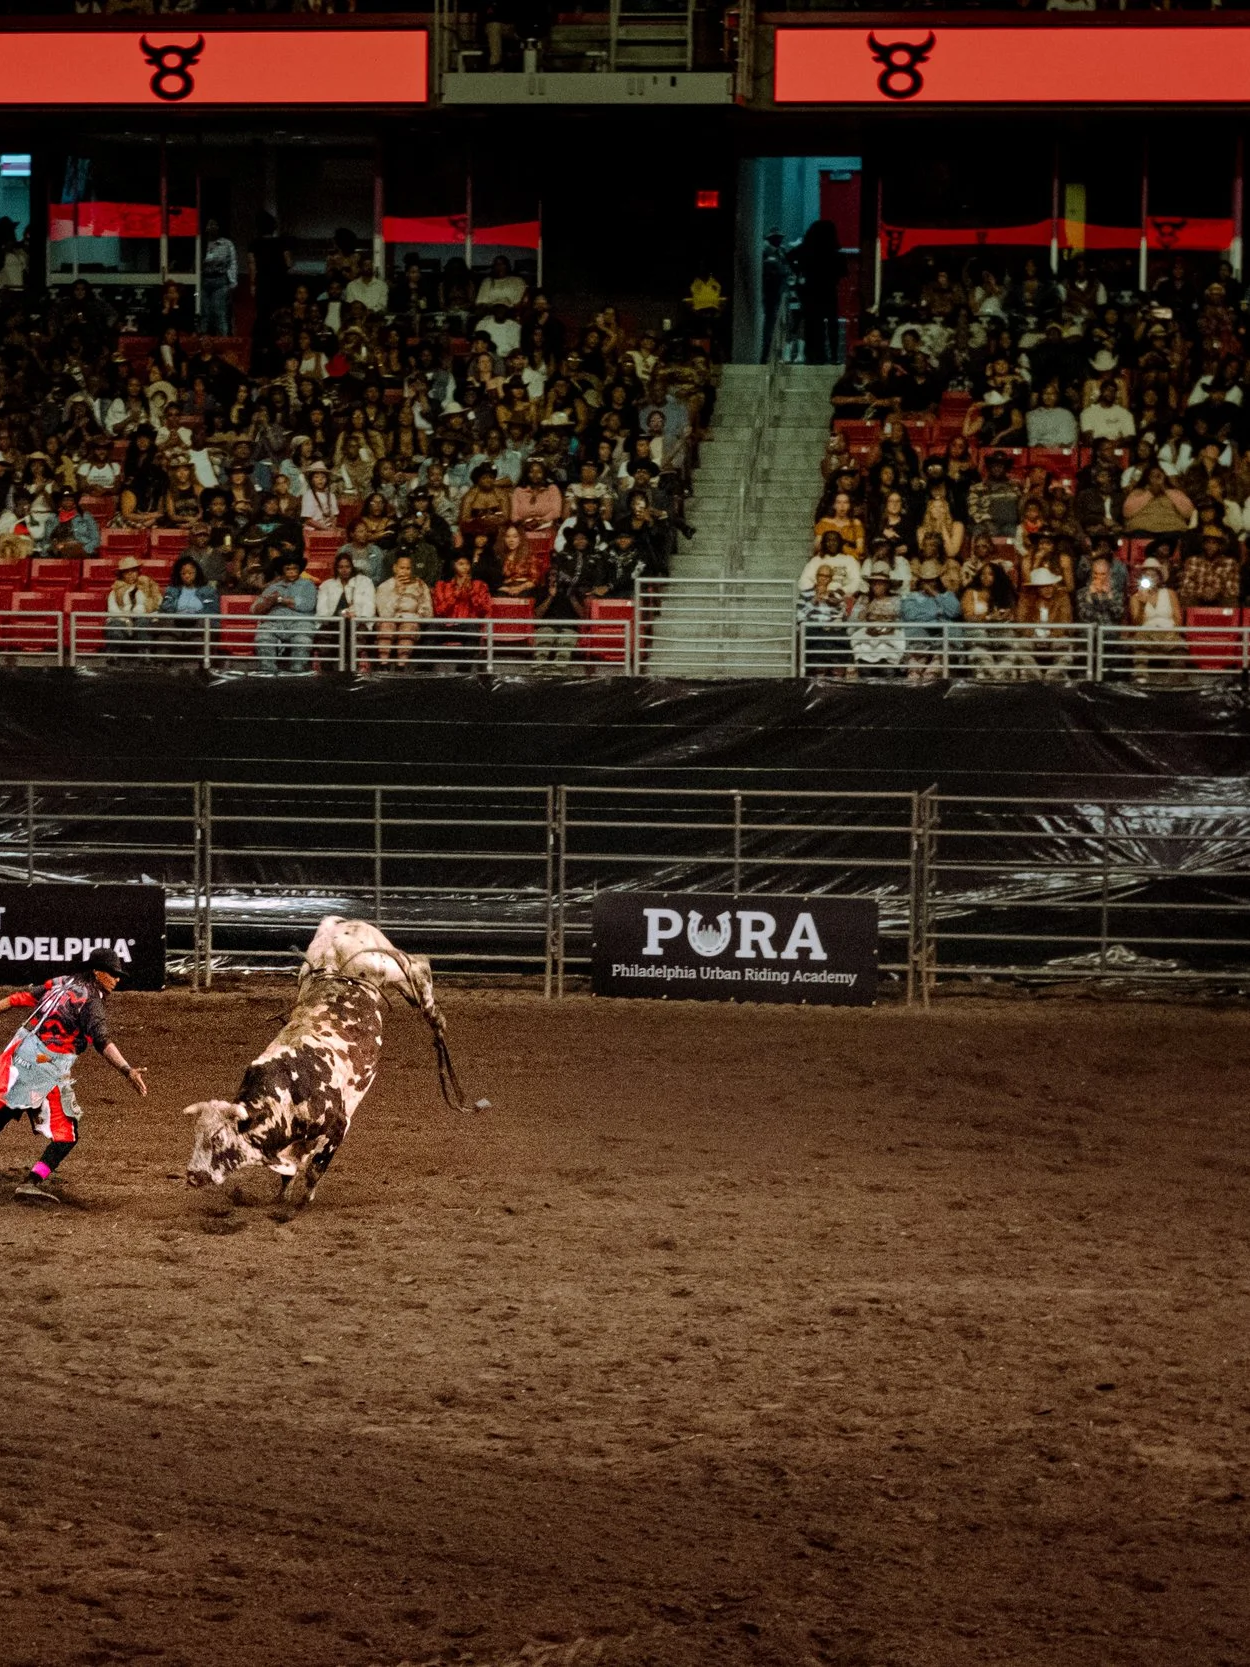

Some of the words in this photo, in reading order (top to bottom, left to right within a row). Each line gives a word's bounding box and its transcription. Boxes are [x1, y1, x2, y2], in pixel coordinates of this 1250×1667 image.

[611, 963, 697, 982] Philadelphia
[699, 966, 742, 981] Urban
[744, 968, 790, 985] Riding
[792, 969, 858, 987] Academy
